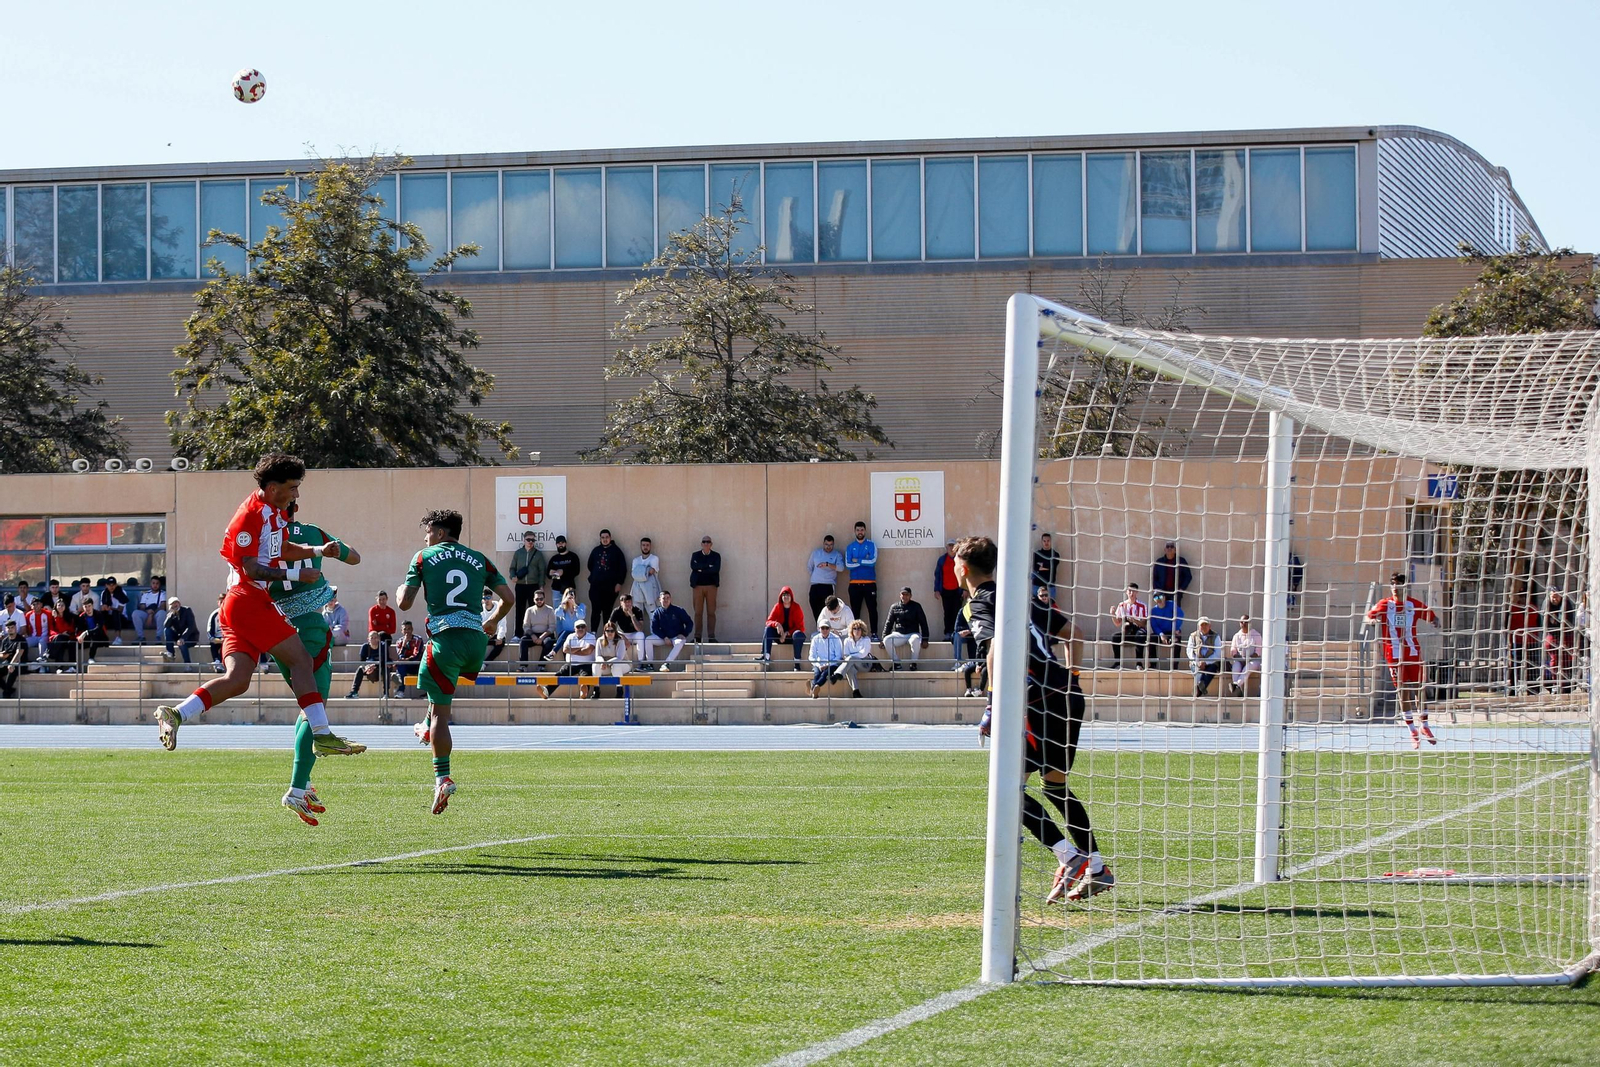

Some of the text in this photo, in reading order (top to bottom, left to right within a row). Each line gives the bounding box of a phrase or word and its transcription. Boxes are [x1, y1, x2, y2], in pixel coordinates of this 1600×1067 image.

[882, 526, 934, 539] ALMERÍA
[518, 542, 545, 550] CAD
[428, 550, 483, 571] IKER PÉREZ
[446, 569, 468, 607] 2
